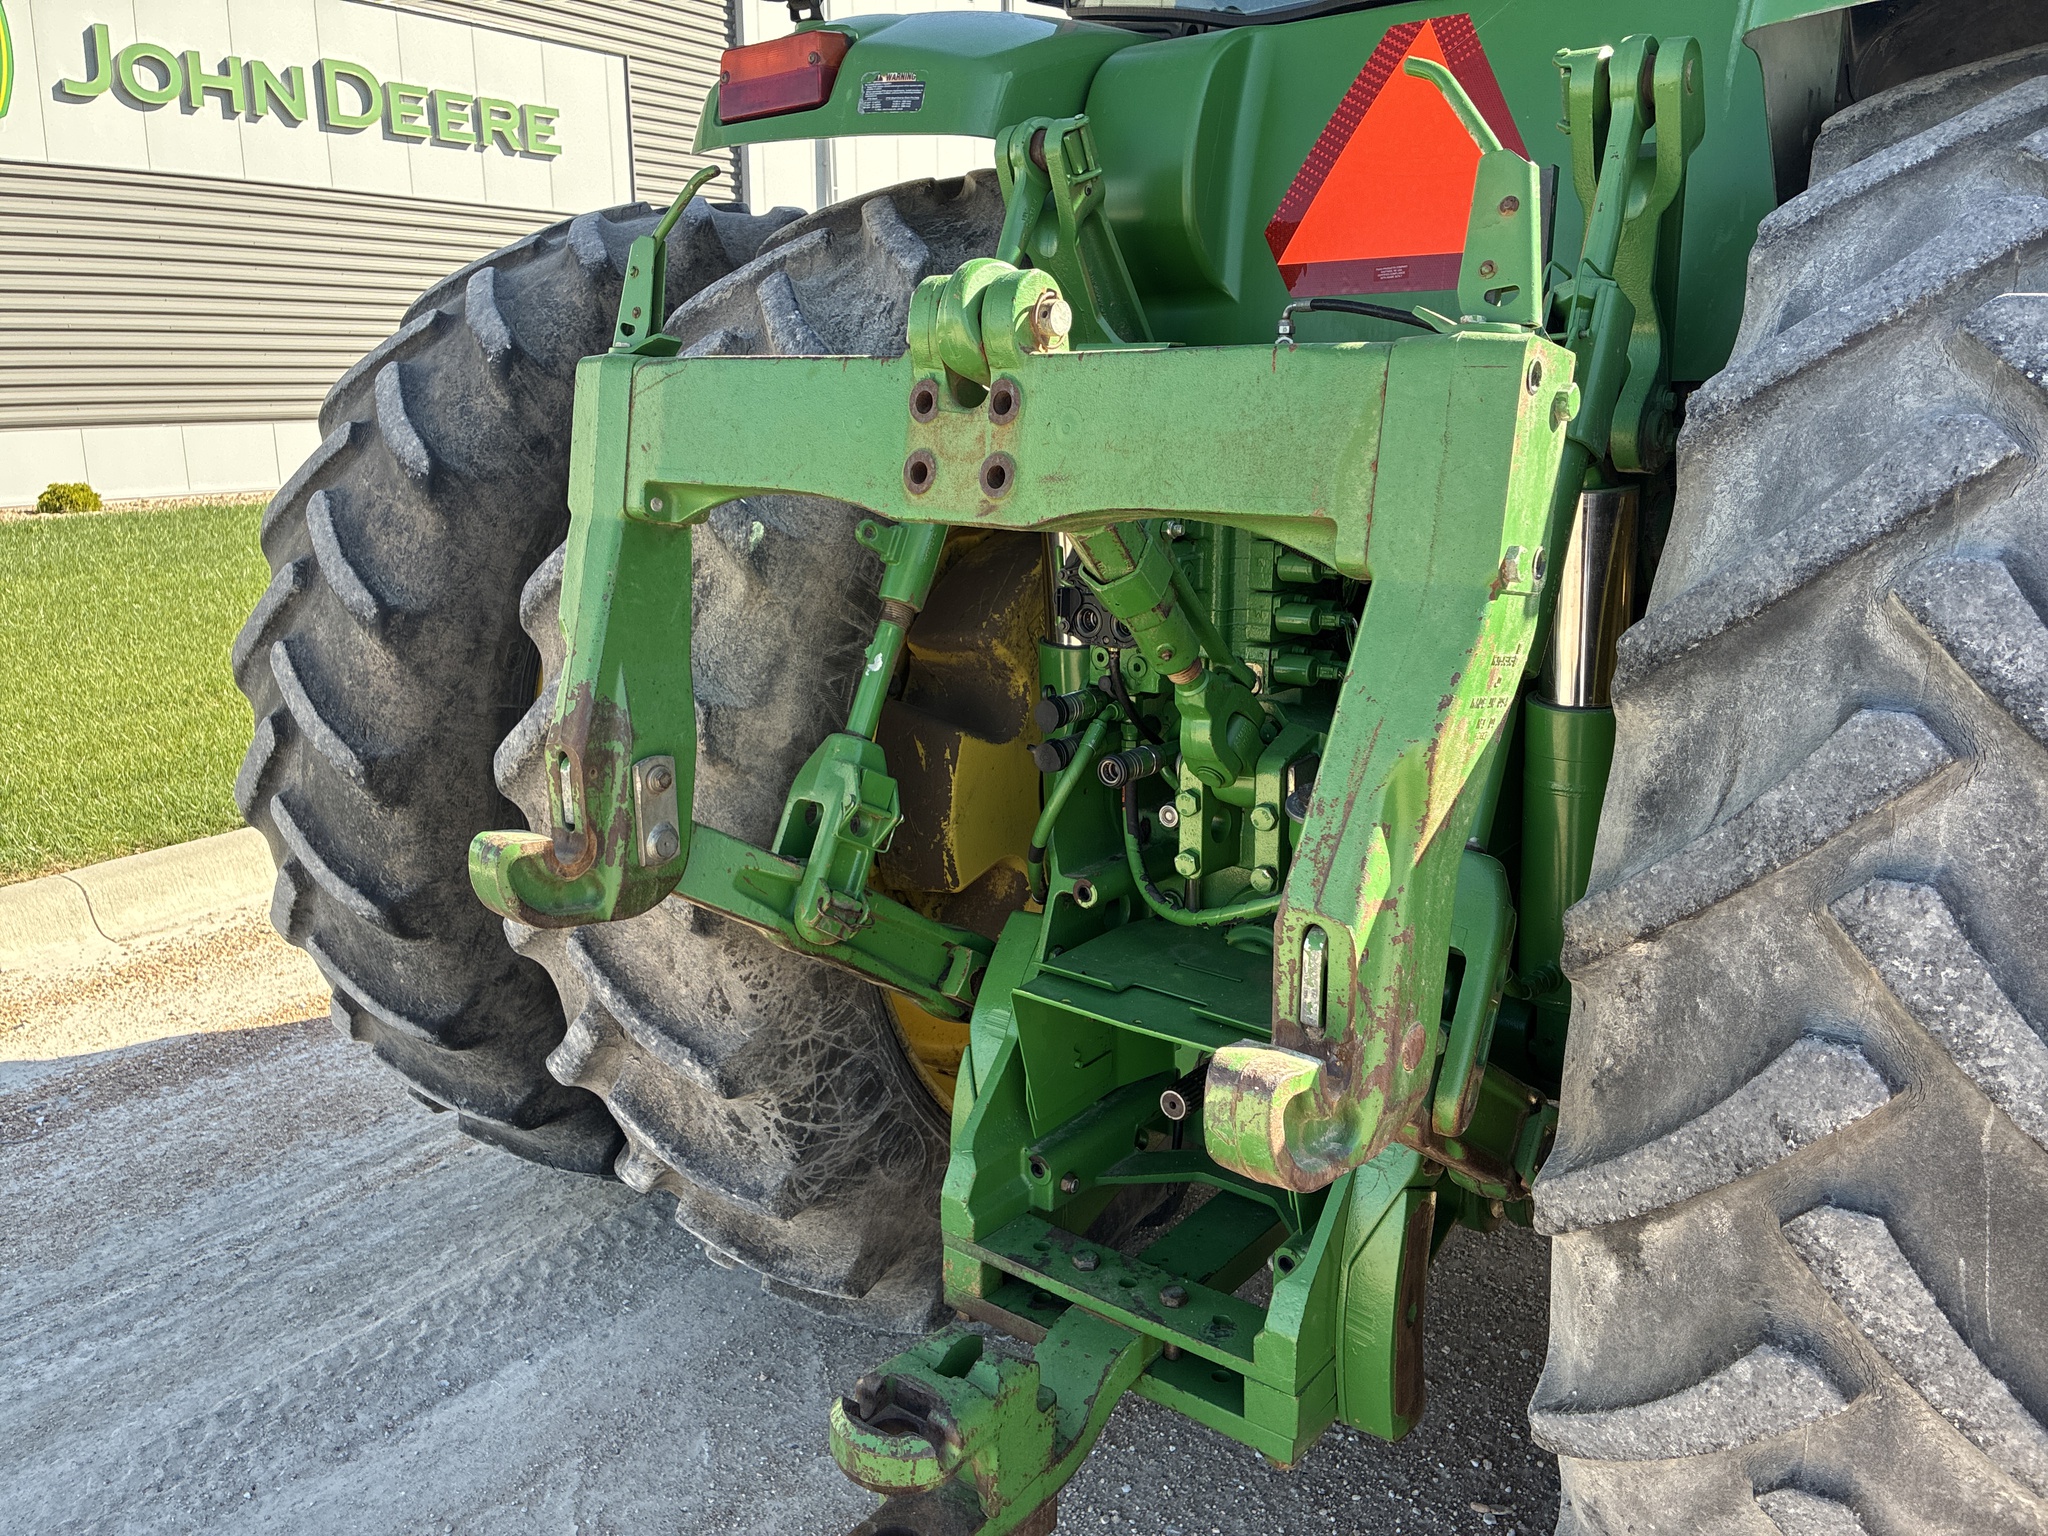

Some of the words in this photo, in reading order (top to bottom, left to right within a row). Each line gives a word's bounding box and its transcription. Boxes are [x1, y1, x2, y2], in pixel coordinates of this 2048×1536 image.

[59, 23, 308, 123] JOHN
[319, 58, 562, 157] DEERE
[886, 72, 917, 82] WARNING
